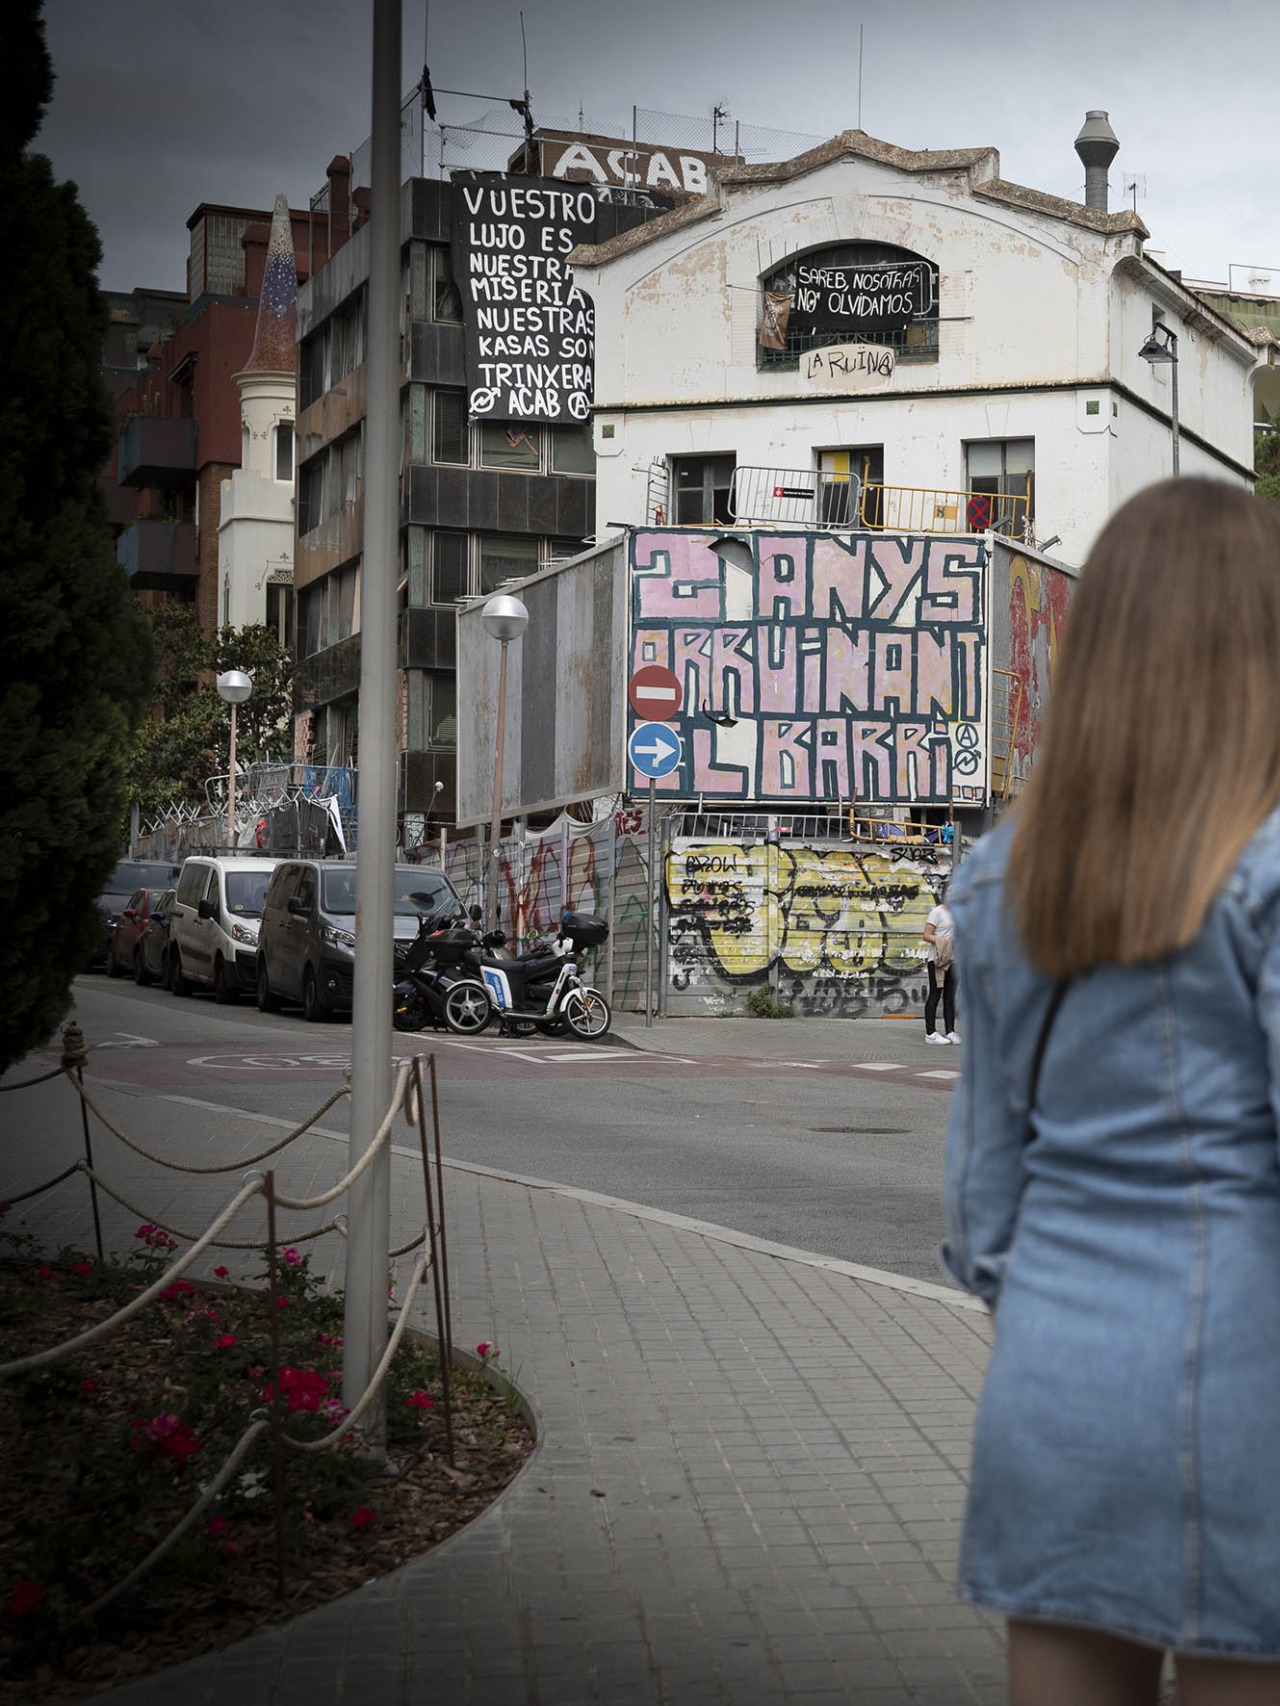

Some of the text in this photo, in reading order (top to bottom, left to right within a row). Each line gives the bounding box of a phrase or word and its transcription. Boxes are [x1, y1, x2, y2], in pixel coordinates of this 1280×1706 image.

[553, 142, 709, 196] ACAB
[463, 187, 595, 224] VUESTRO
[470, 222, 574, 253] LUJO ES
[470, 276, 585, 309] MISERIA
[799, 267, 850, 291] SAREB,
[478, 334, 550, 357] KASAS
[808, 353, 823, 379] LA
[508, 388, 561, 417] ACAB
[752, 530, 986, 626] ANYS
